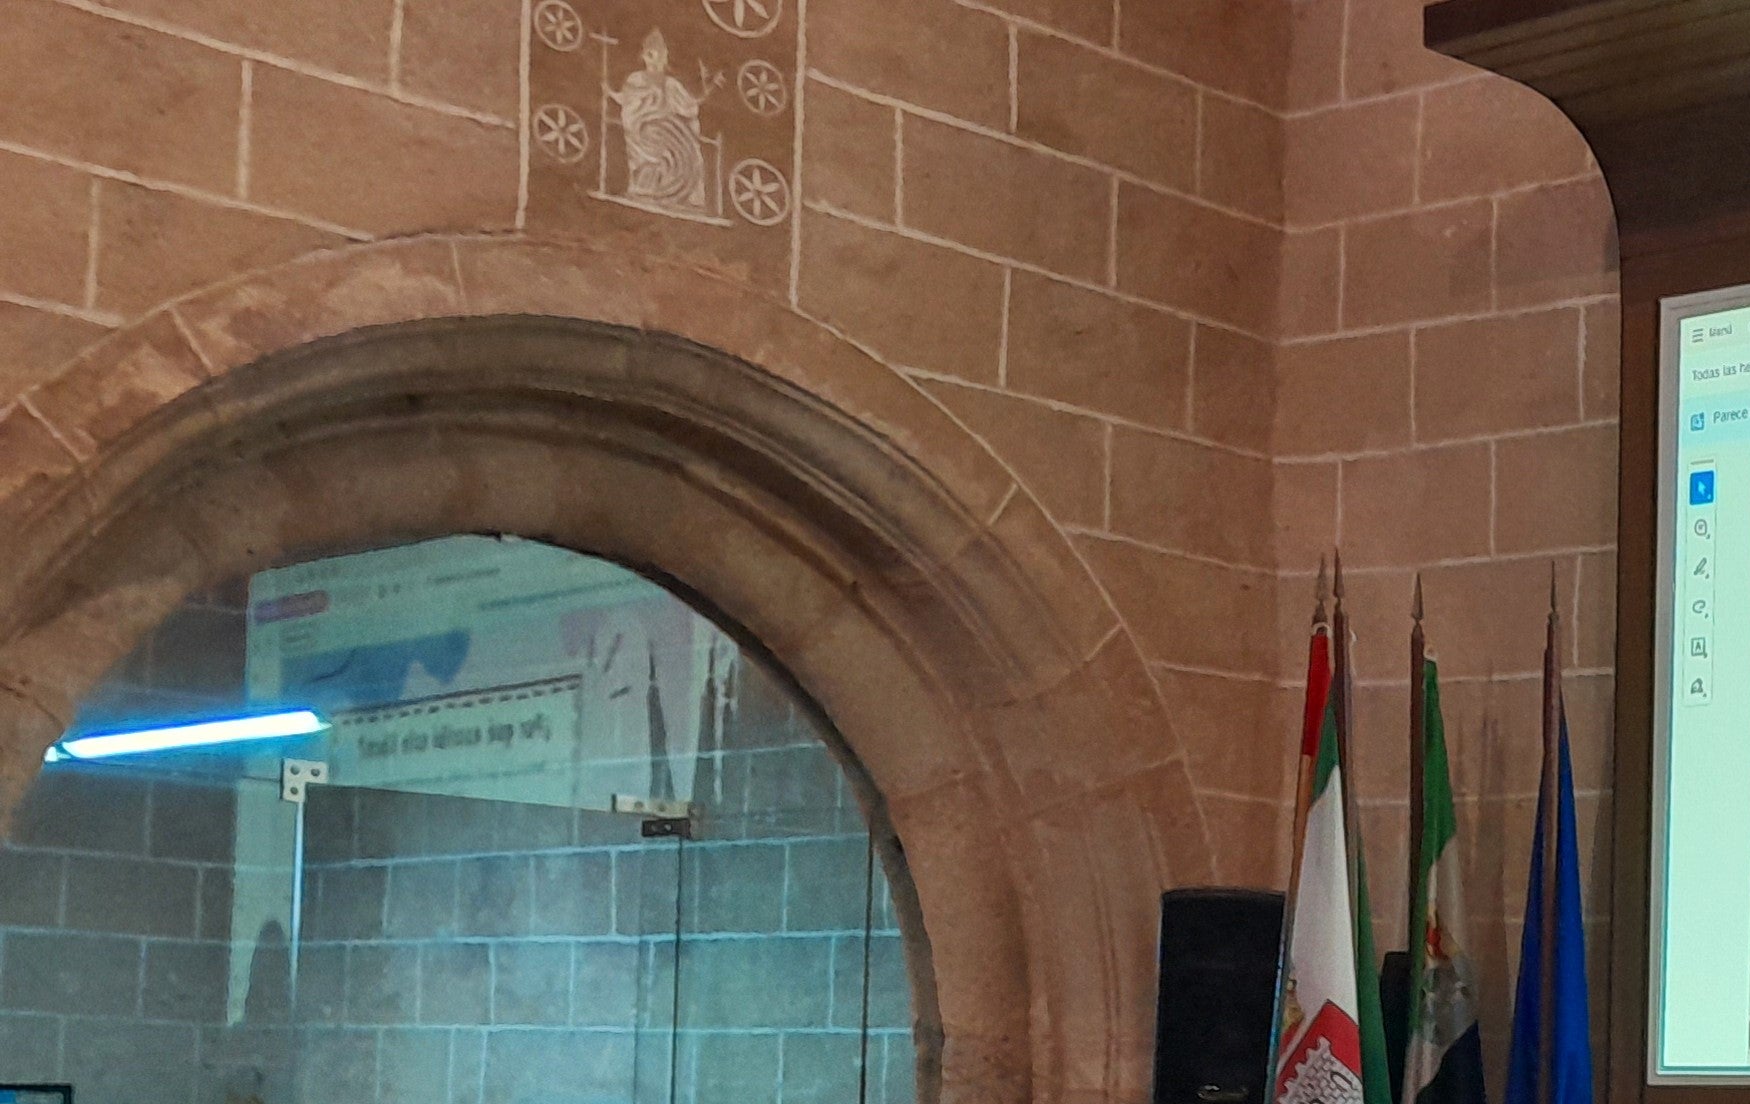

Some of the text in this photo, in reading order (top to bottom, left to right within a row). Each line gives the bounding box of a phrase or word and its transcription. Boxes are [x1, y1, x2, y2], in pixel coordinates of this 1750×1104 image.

[1692, 366, 1720, 381] Todas
[1723, 363, 1737, 376] las
[1713, 408, 1748, 424] Parece
